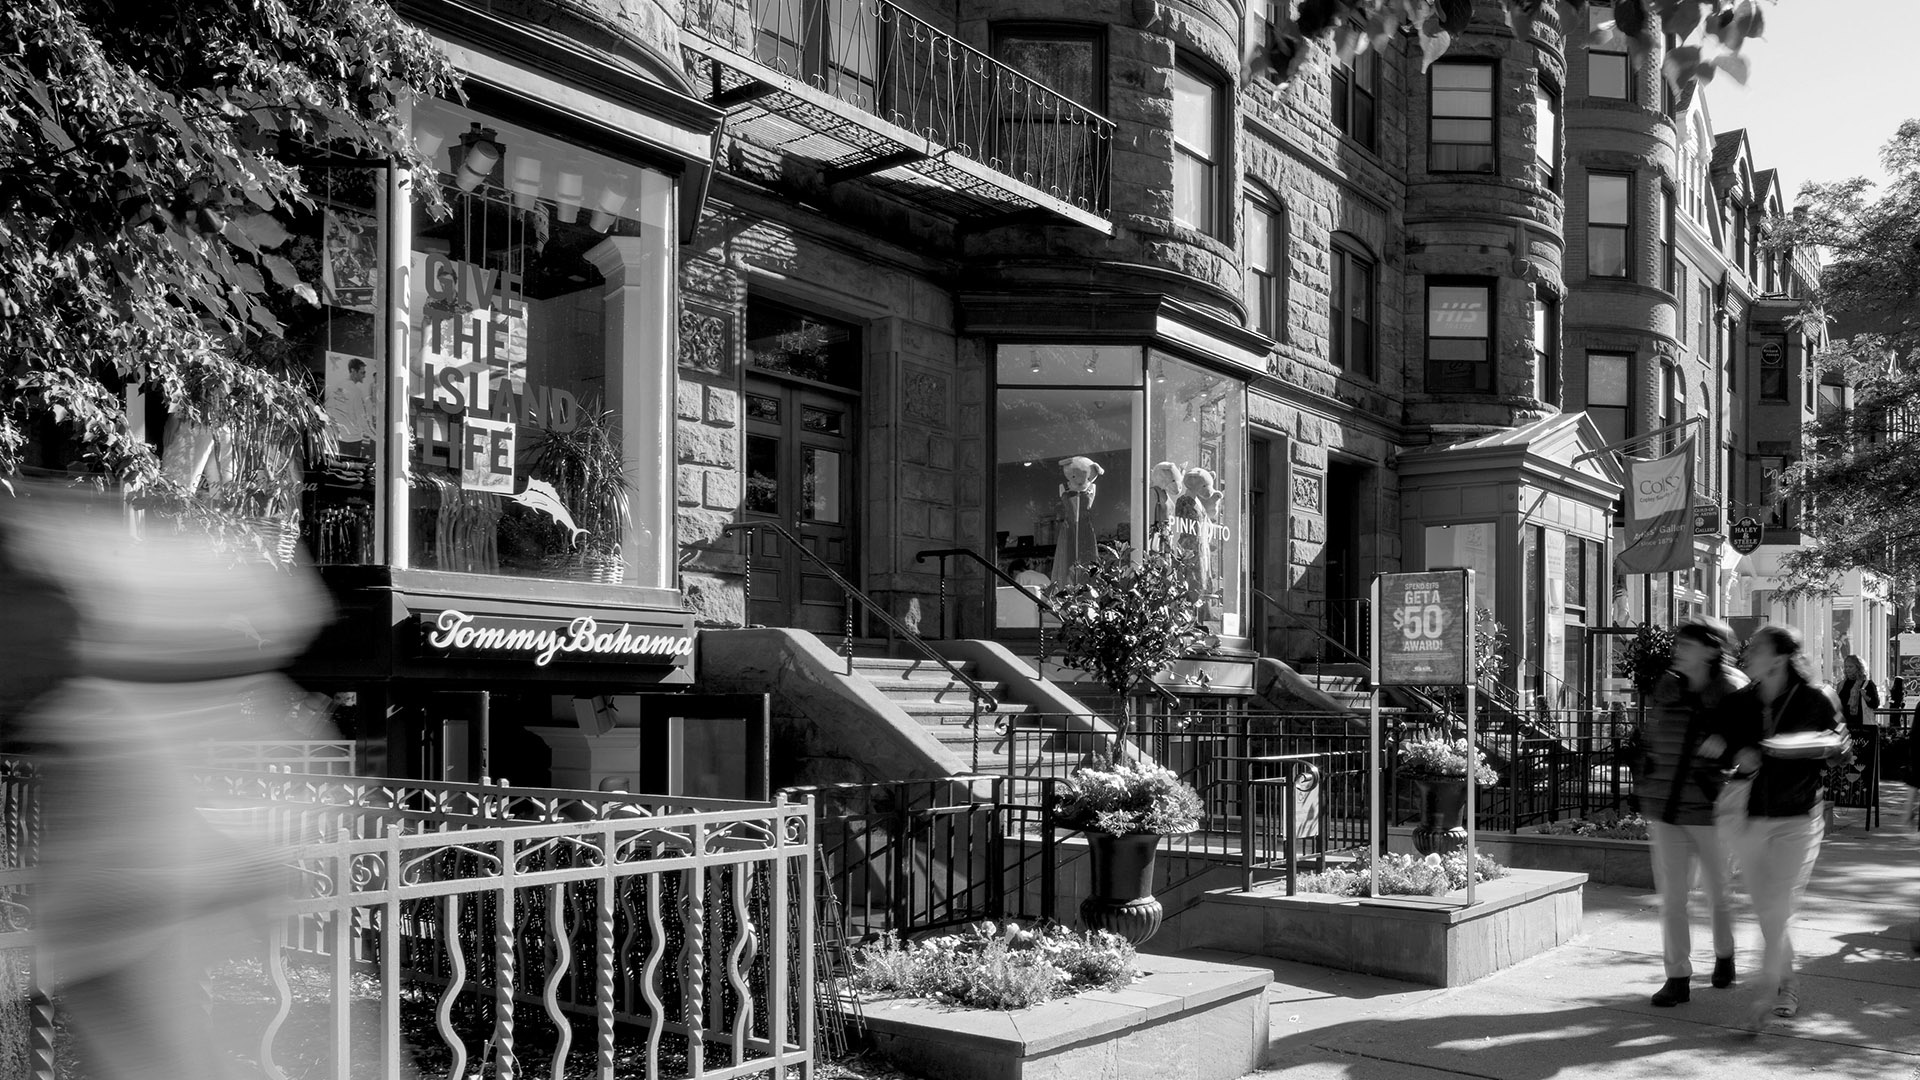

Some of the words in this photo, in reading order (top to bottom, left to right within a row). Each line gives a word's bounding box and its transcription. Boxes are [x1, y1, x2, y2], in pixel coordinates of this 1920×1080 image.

[423, 252, 524, 319] GIVE
[423, 308, 509, 368] THE
[422, 362, 578, 433] ISLAND
[423, 417, 514, 476] LIFE
[1392, 604, 1443, 640] $50
[1405, 590, 1430, 604] GET
[1431, 589, 1440, 604] A
[429, 609, 562, 667] Tommy
[559, 614, 694, 657] Bahama
[1403, 639, 1443, 652] AWARD!
